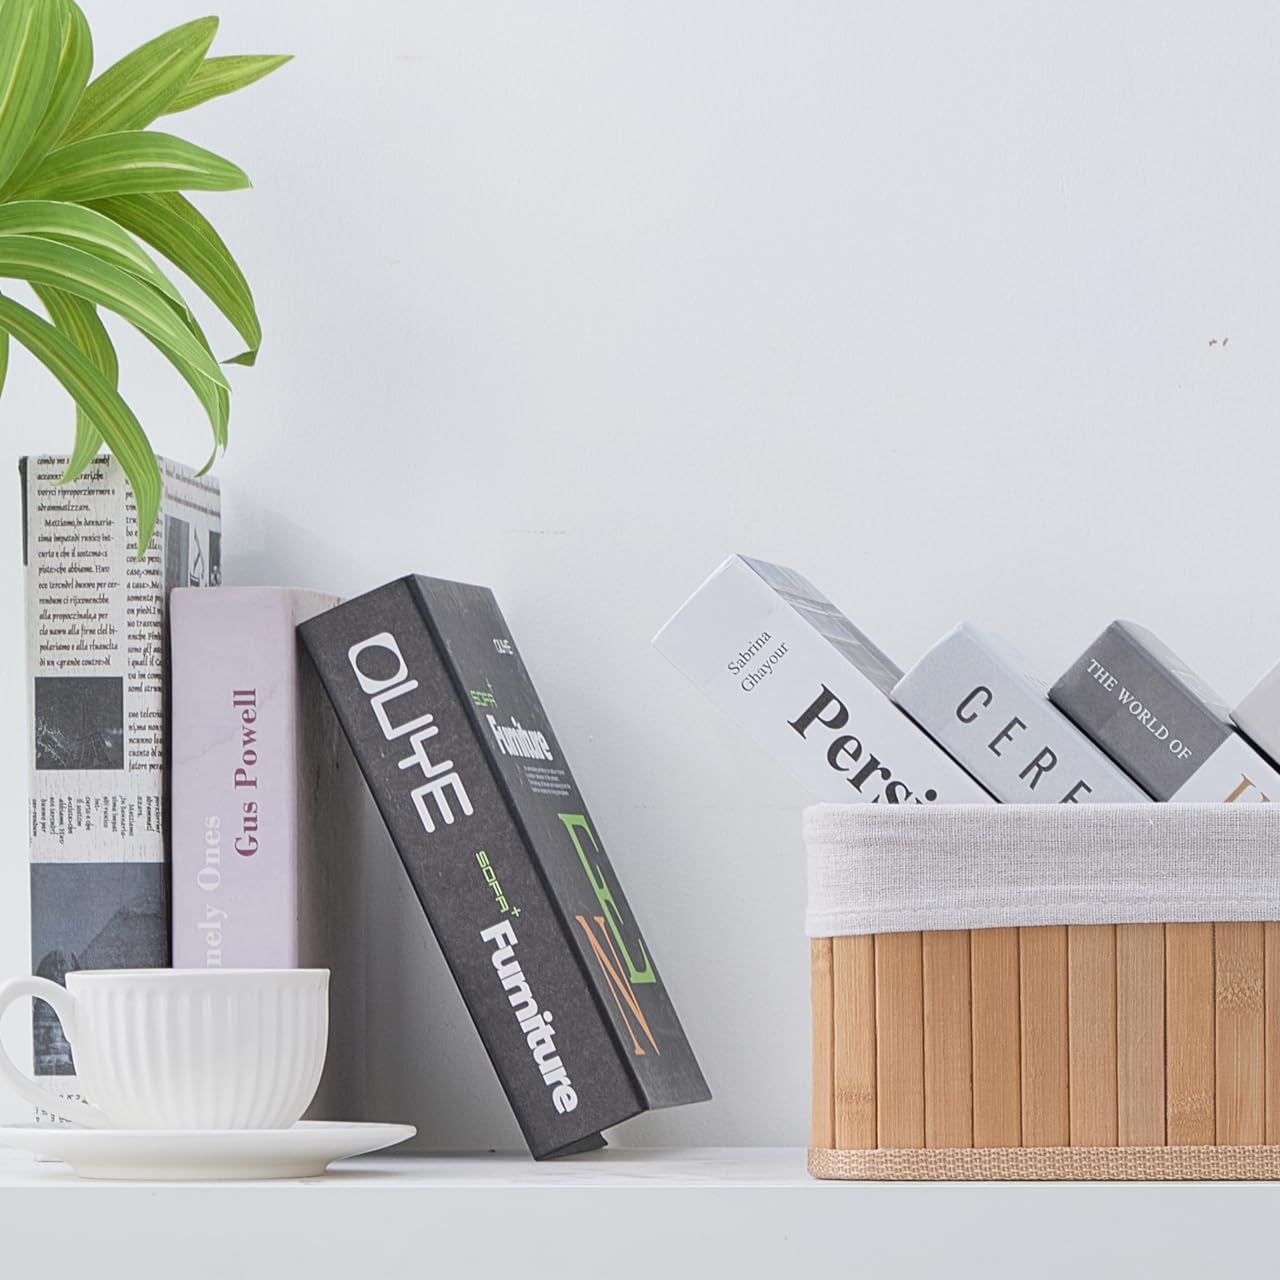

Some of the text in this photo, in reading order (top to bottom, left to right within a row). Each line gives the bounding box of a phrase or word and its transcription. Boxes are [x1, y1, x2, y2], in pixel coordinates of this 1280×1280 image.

[727, 629, 773, 676] Sabrina
[740, 641, 789, 694] Ghayour
[486, 714, 554, 761] Furniture
[1086, 658, 1193, 760] THE WORLD OF
[233, 687, 259, 857] Gus Powell
[197, 814, 222, 892] Ones
[479, 918, 579, 1115] Furniture
